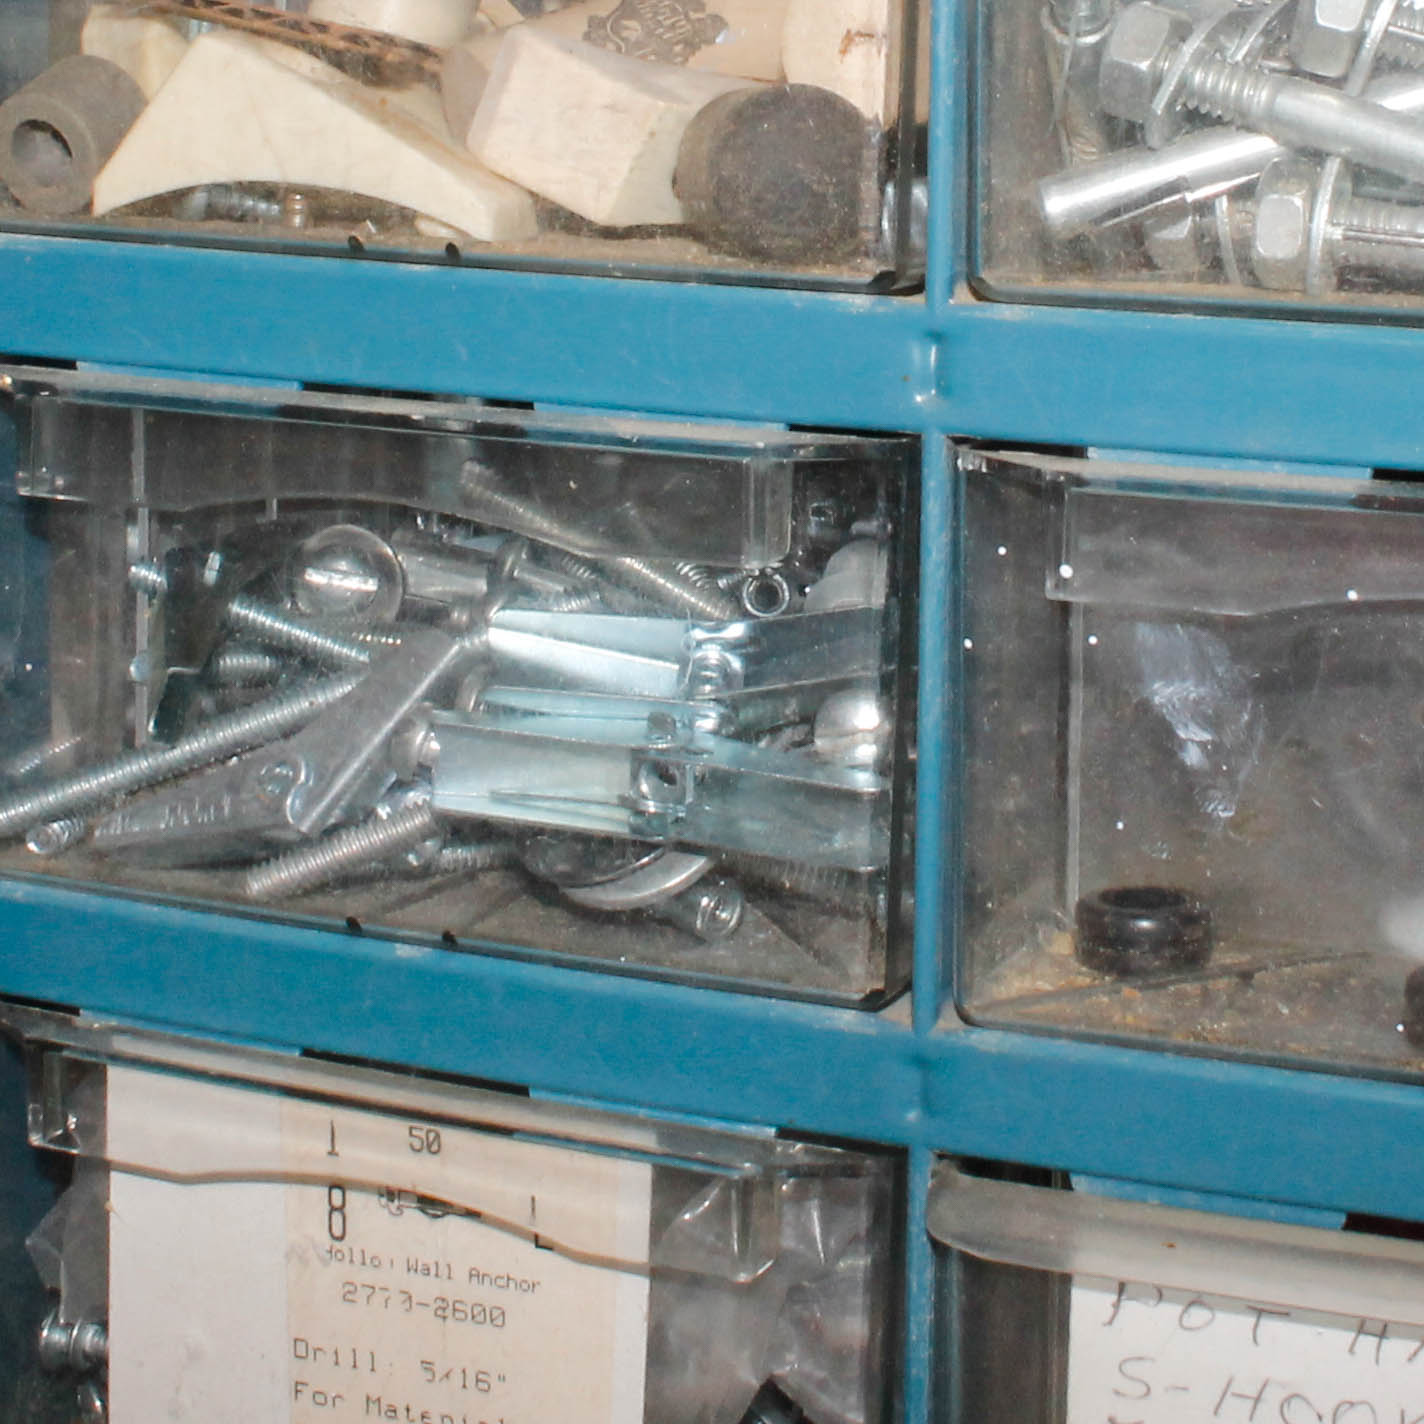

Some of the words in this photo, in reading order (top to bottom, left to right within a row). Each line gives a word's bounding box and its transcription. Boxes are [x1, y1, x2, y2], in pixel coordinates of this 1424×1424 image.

[408, 1125, 441, 1155] 50
[406, 1257, 454, 1280] Wall
[468, 1266, 542, 1294] Anchor
[294, 1380, 344, 1410] For
[364, 1393, 506, 1424] Mater
